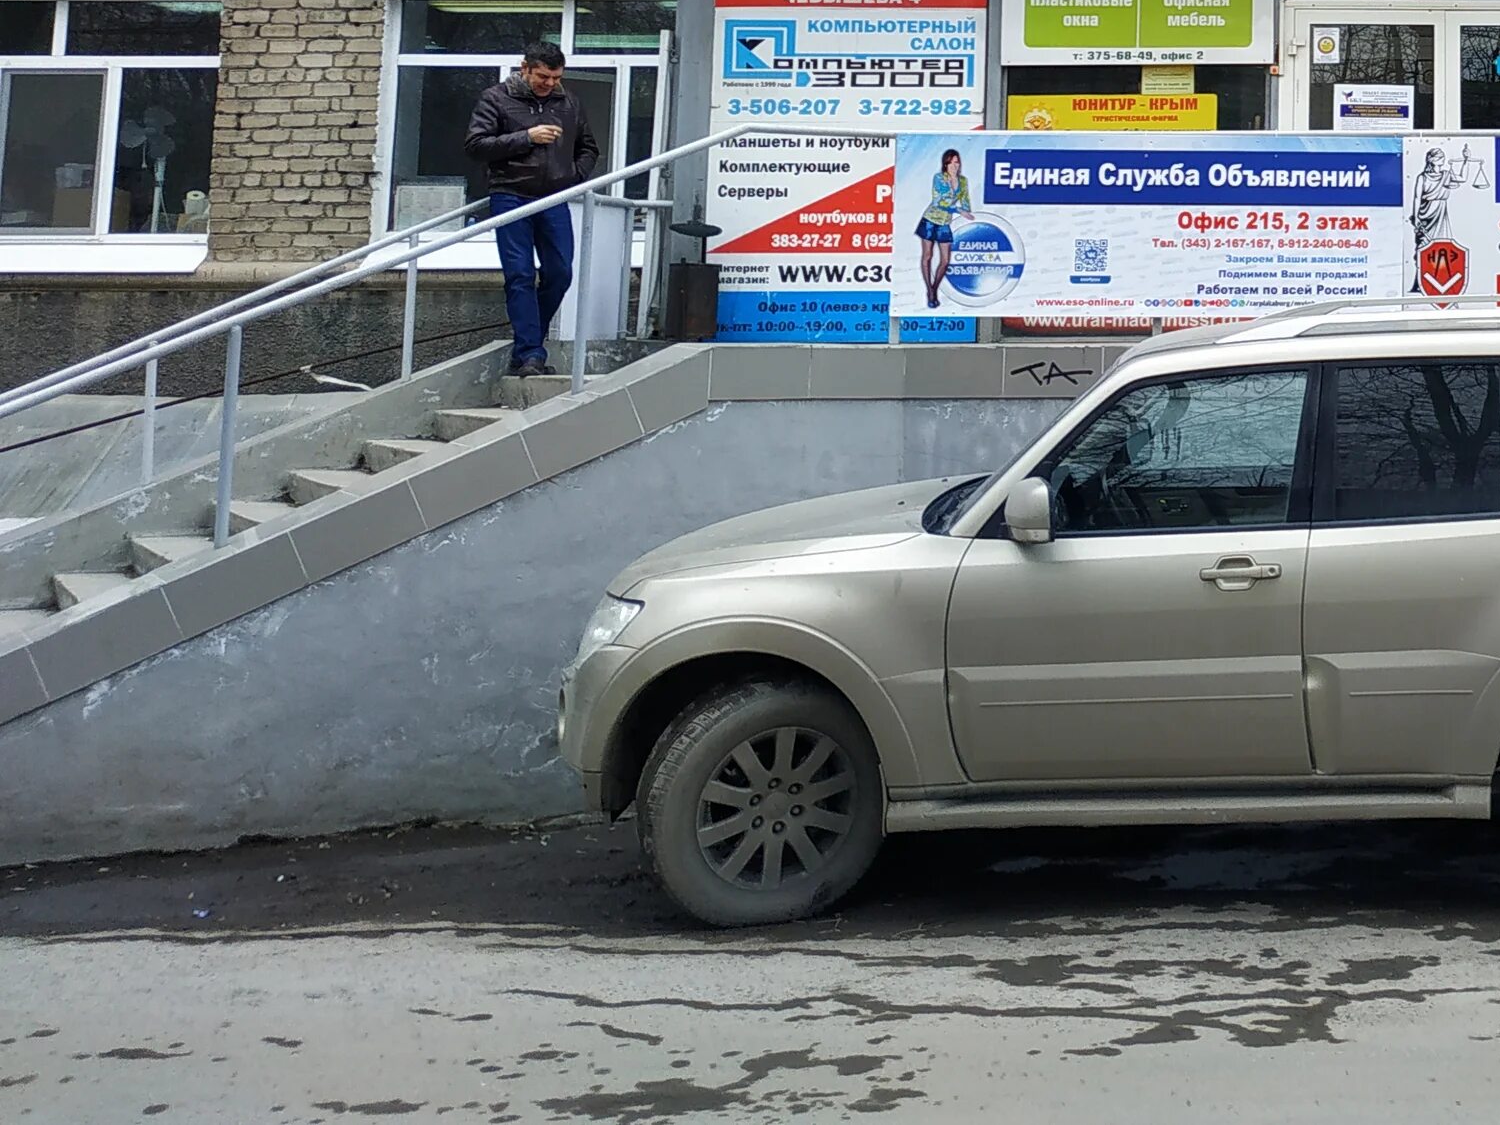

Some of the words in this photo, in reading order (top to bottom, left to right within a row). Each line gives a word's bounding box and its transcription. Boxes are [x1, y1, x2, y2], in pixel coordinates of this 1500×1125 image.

[807, 16, 977, 33] КОМПЬЮТЕРНЫЙ
[1063, 14, 1099, 26] окна
[1167, 13, 1225, 27] мебель
[910, 37, 976, 51] САЛОН
[1087, 51, 1157, 62] 375-68-49,
[1161, 52, 1192, 63] офис
[1196, 51, 1204, 60] 2
[728, 98, 841, 115] 3-506-207
[858, 98, 972, 115] 3-722-982
[1072, 98, 1136, 111] ЮНИТУР
[1149, 98, 1198, 110] КРЫМ
[806, 138, 814, 148] и
[820, 137, 890, 150] ноутбуки
[719, 160, 850, 175] Комплектующие
[993, 162, 1090, 189] Единая
[1098, 162, 1200, 192] Служба
[1208, 164, 1370, 188] Объявлений
[718, 185, 788, 200] Серверы
[799, 210, 875, 226] ноутбуков
[878, 213, 888, 223] и
[1177, 211, 1239, 233] Офис
[1246, 212, 1290, 233] 215,
[1297, 212, 1310, 229] 2
[1316, 216, 1369, 230] этаж
[771, 234, 842, 247] 383-27-27
[852, 234, 861, 247] 8
[959, 241, 998, 250] ЕДИНАЯ
[1152, 238, 1178, 248] Тел.
[1181, 238, 1211, 250] (343)
[1214, 239, 1274, 250] 2-167-167,
[1277, 239, 1369, 249] 8-912-240-06-40
[1225, 255, 1274, 266] Закроем
[1277, 255, 1308, 264] Ваши
[1310, 255, 1368, 264] вакансии!
[1218, 269, 1278, 280] Поднимем
[1281, 269, 1312, 279] Ваши
[1314, 270, 1368, 281] продажи!
[1197, 284, 1259, 295] Работаем
[1263, 287, 1278, 295] по
[1282, 284, 1312, 295] всей
[1316, 284, 1368, 295] России!
[758, 301, 796, 313] Офис
[801, 301, 817, 312] 10
[1036, 297, 1136, 307] www.eso-online.ru
